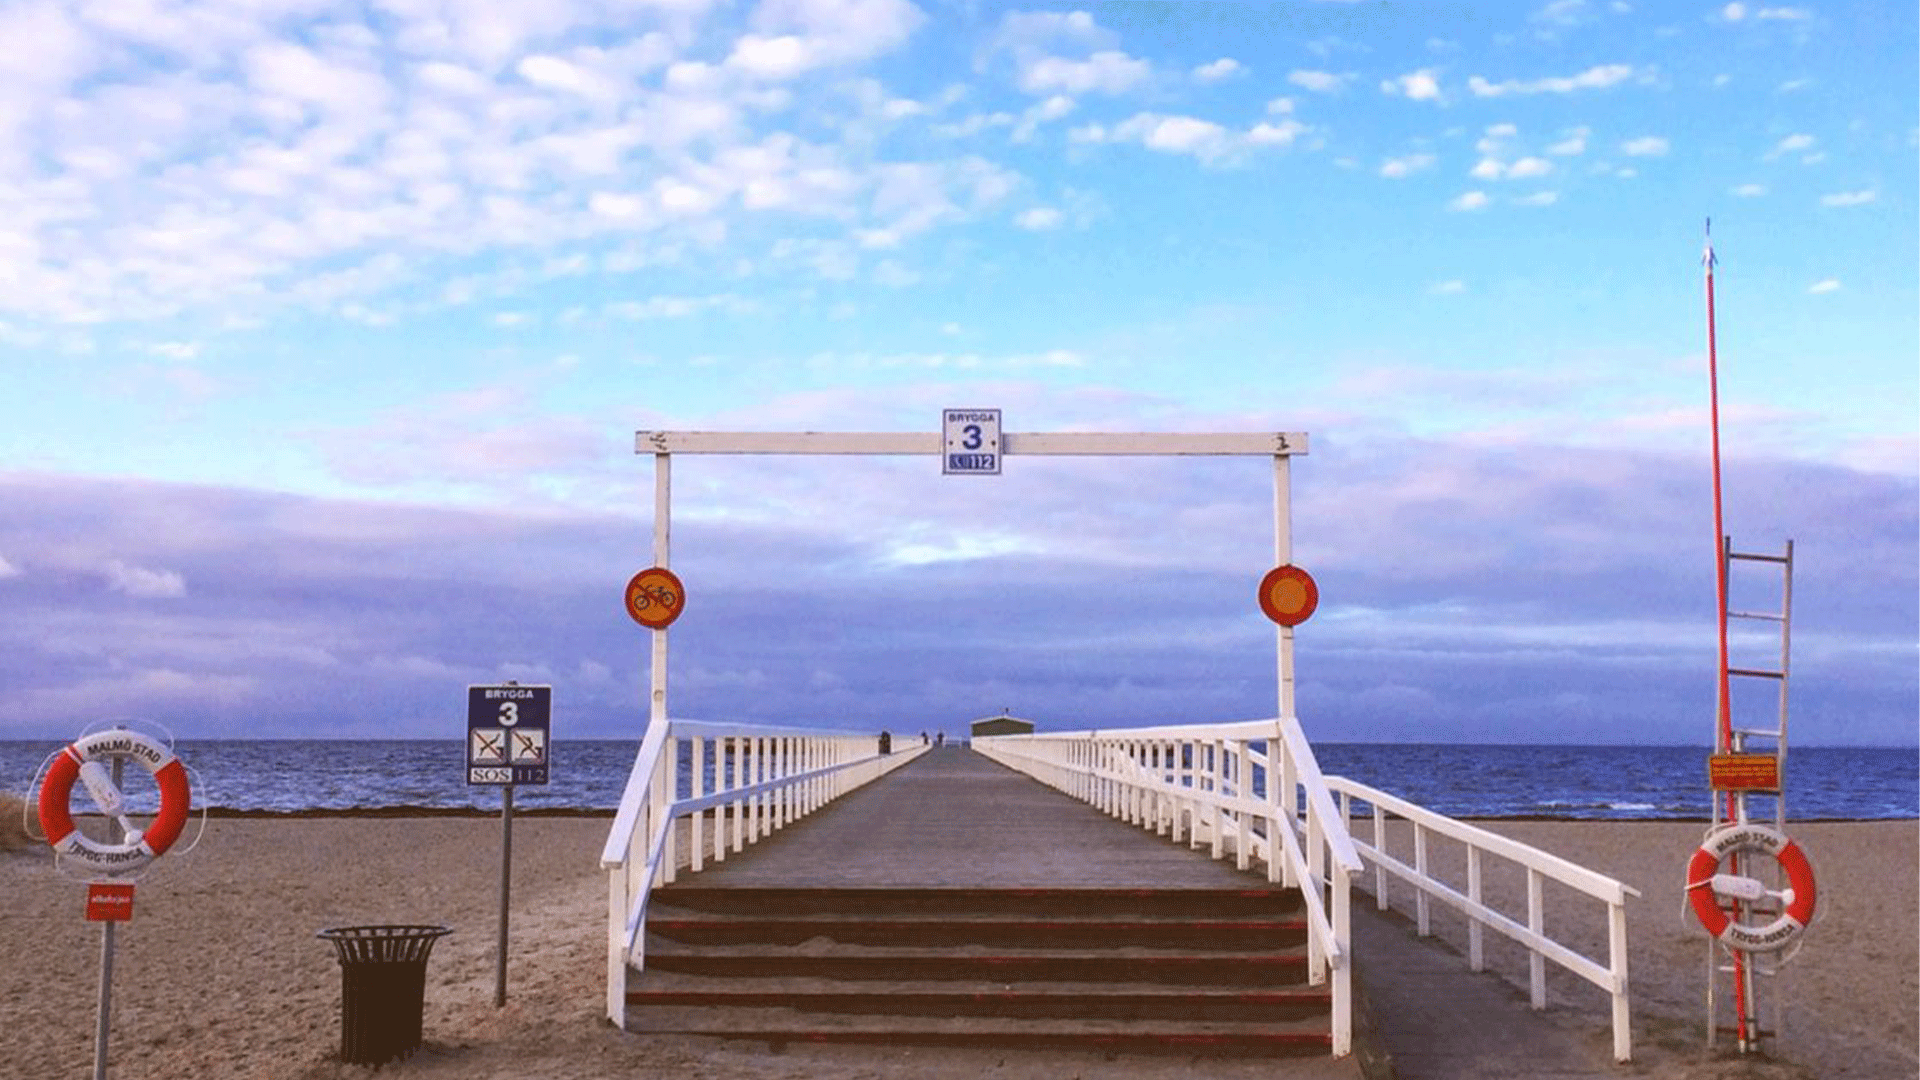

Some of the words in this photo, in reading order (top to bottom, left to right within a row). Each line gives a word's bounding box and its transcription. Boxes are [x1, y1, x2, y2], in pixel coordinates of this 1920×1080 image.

[948, 413, 995, 422] BRYGGA
[962, 424, 982, 450] 3
[970, 455, 992, 468] 112
[485, 689, 534, 699] BRYGGA
[498, 701, 519, 726] 3
[87, 739, 132, 755] MALMÖ
[133, 743, 161, 763] STAD
[473, 770, 510, 780] SOS
[518, 769, 544, 781] 112
